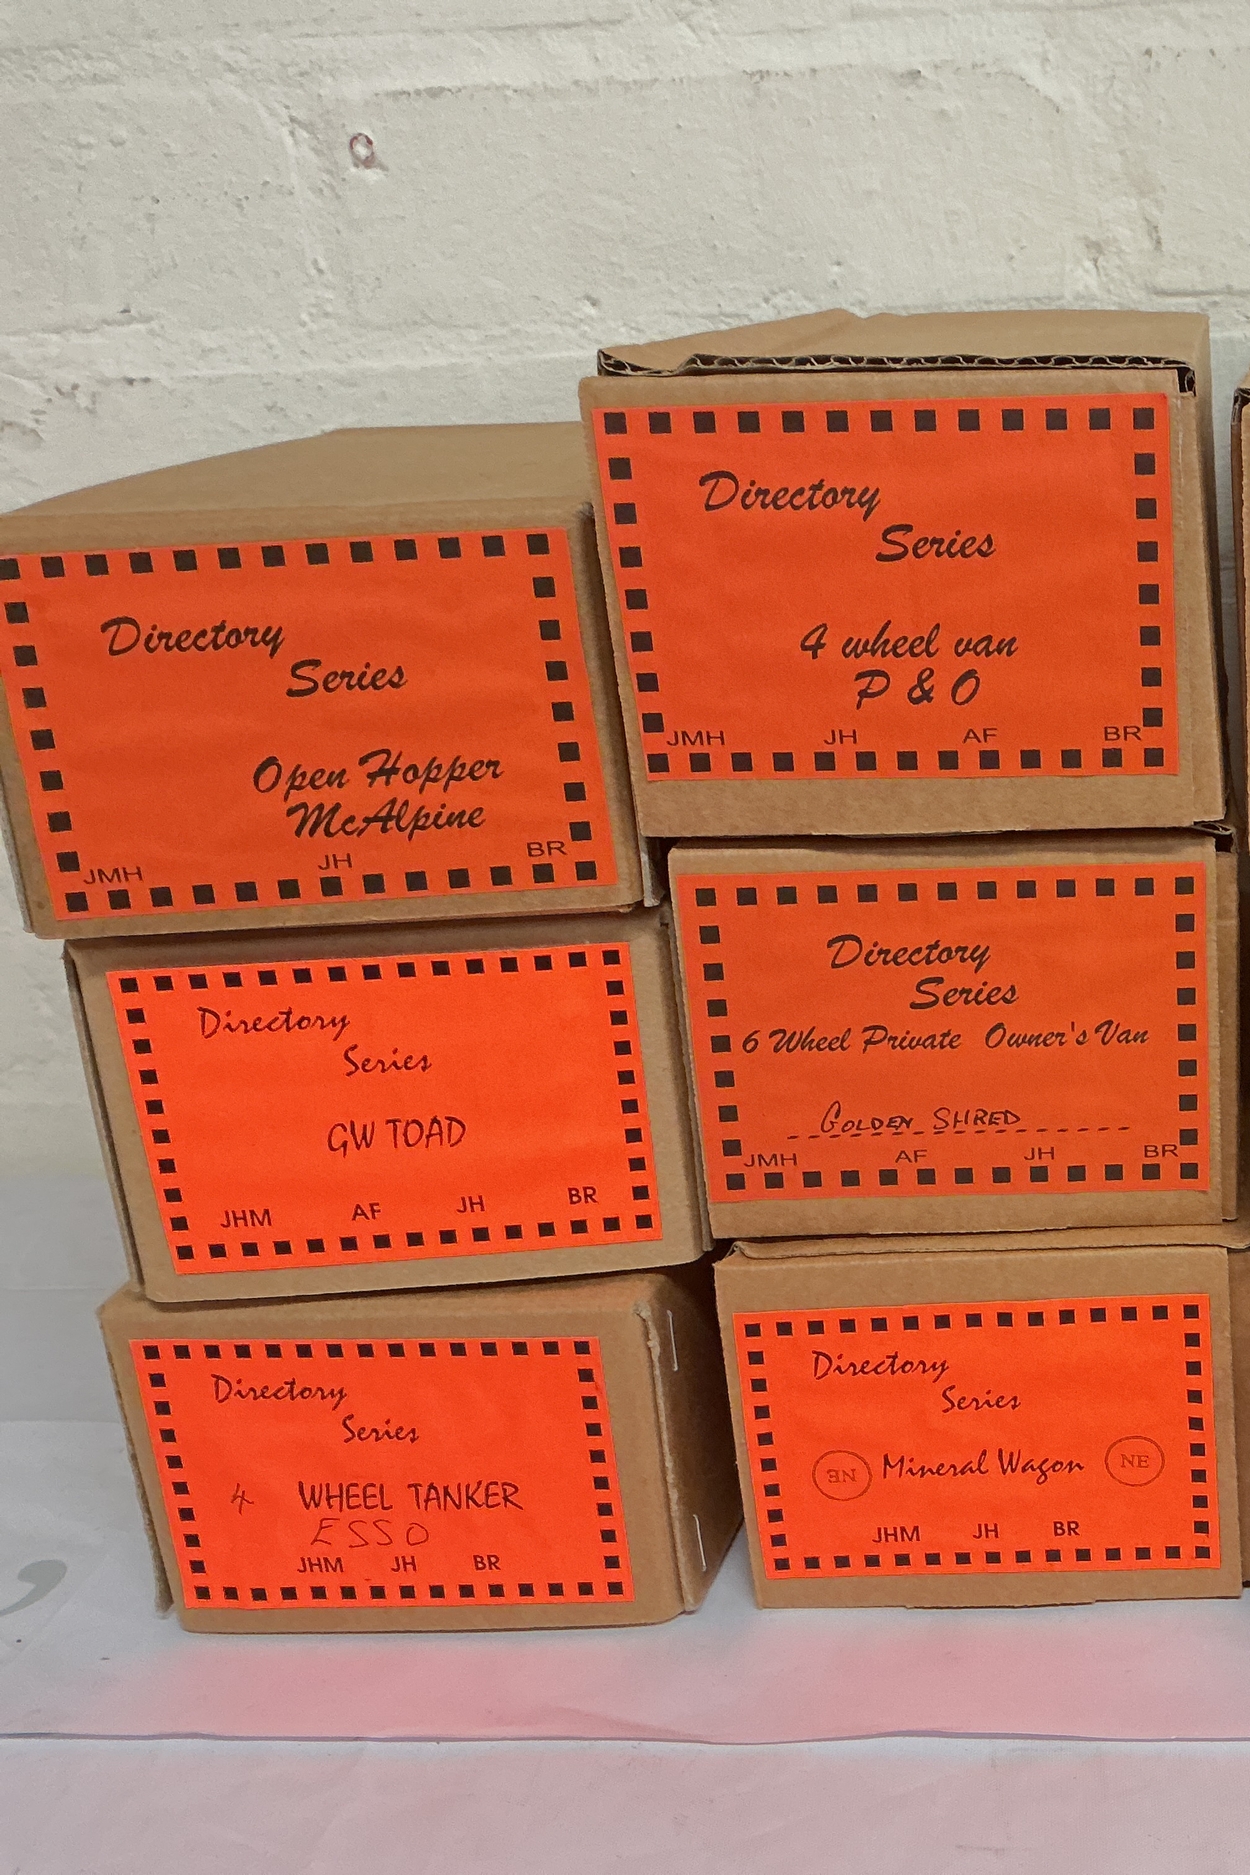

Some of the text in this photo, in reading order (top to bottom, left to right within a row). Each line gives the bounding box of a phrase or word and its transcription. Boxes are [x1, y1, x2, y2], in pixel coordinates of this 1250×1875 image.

[698, 470, 881, 518] Directory
[875, 524, 997, 562] Series
[101, 617, 285, 661] Directory
[799, 624, 1018, 660] 4 wheel van
[286, 658, 407, 698] Series
[854, 668, 981, 709] P & O
[666, 725, 1142, 747] JMH JH AF BR
[252, 748, 503, 801] Open Hopper
[286, 797, 486, 842] McAlpine
[83, 840, 567, 885] JMH JH BR
[826, 934, 991, 974] Directory
[909, 977, 1019, 1011] Series
[196, 1006, 350, 1040] Directory
[742, 1019, 1150, 1054] 6 Wheel Private Owner's Van
[343, 1042, 432, 1076] Series
[932, 1107, 1020, 1130] SHRED
[326, 1115, 466, 1158] GW TOAD
[743, 1143, 1179, 1167] JMH AF JH BR
[220, 1186, 598, 1228] JHM AF JH BR
[811, 1350, 949, 1384] Directory
[211, 1374, 348, 1410] Directory
[941, 1386, 1021, 1414] Series
[342, 1412, 419, 1444] Series
[882, 1447, 1085, 1486] Mineral Wagon
[1120, 1453, 1150, 1470] NE
[298, 1480, 394, 1512] WHEEL
[406, 1481, 524, 1510] TANKER
[310, 1518, 429, 1548] ESSO
[872, 1520, 1080, 1544] JHM JH BR
[297, 1553, 501, 1575] JHM JH BR
